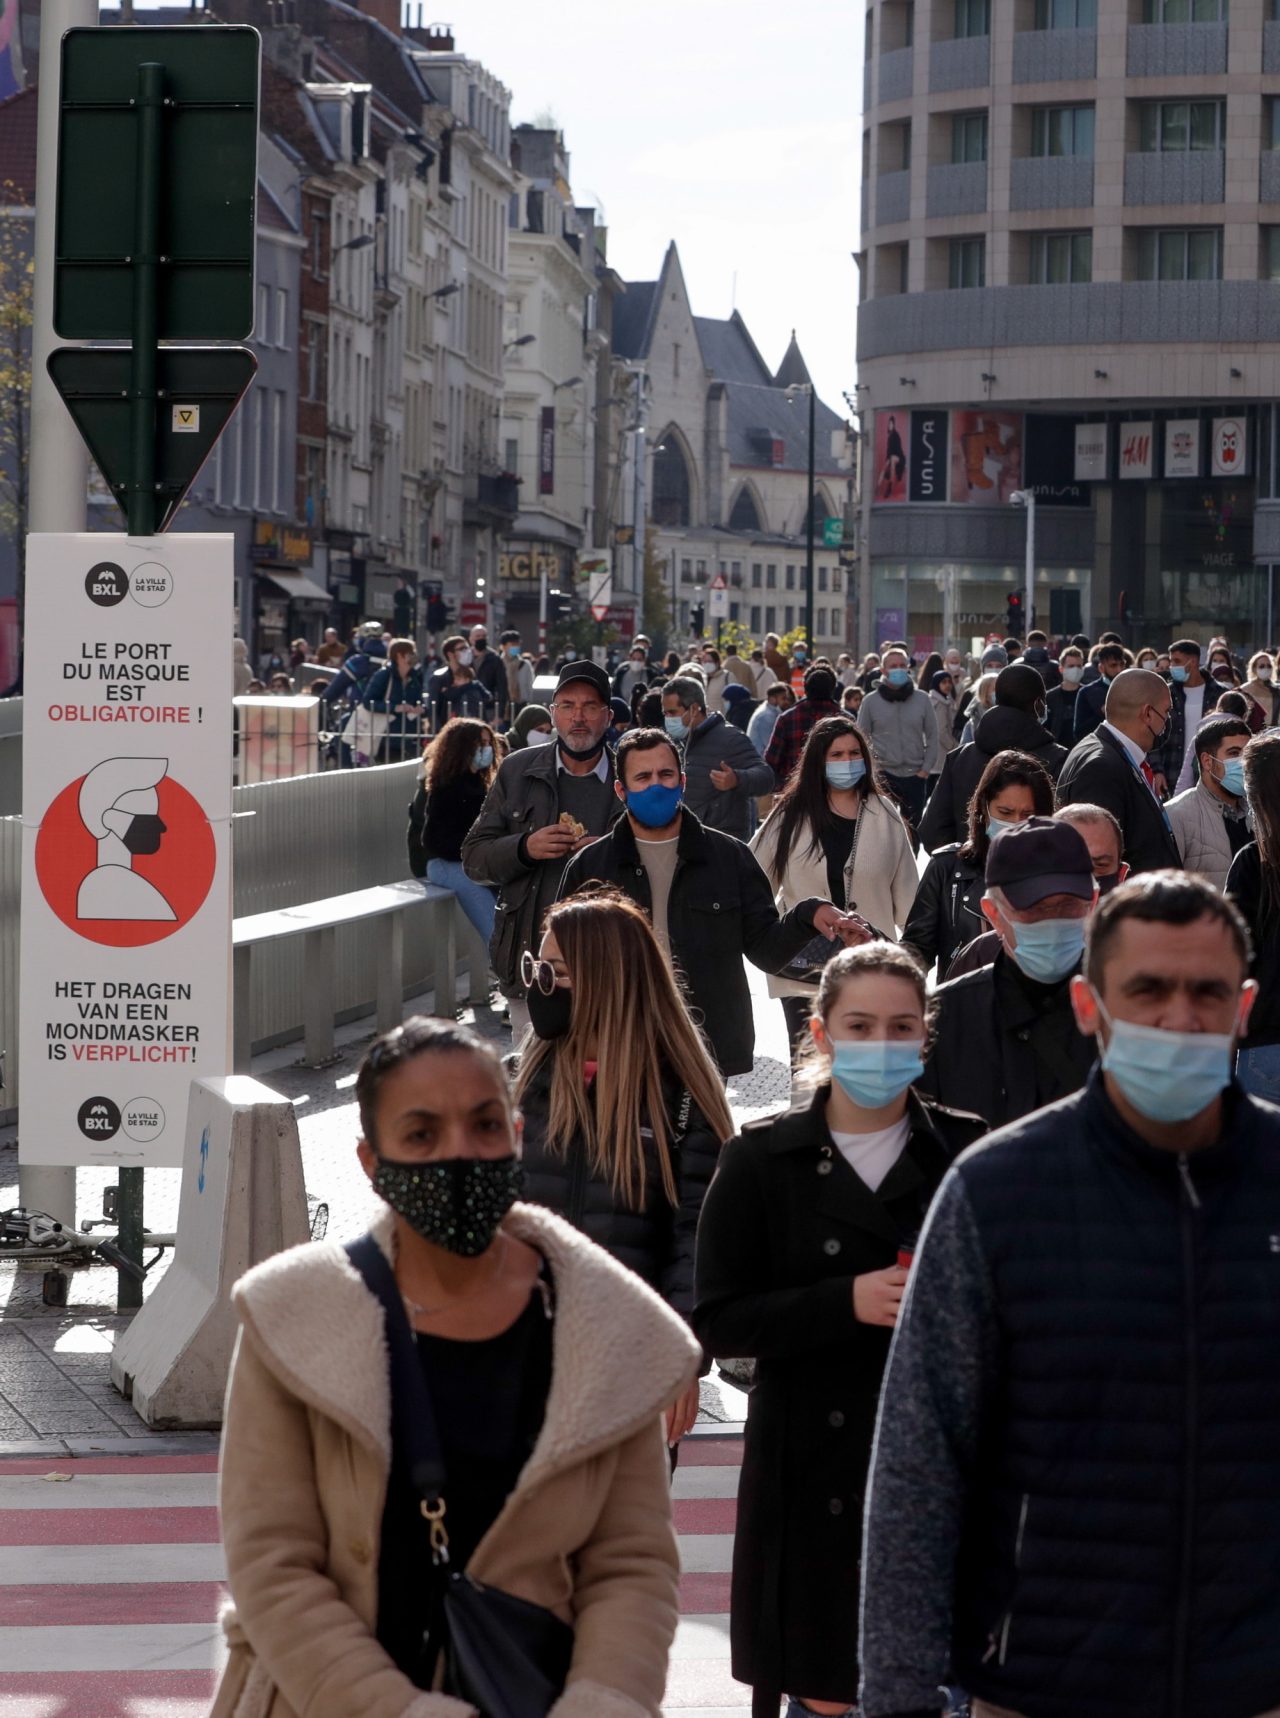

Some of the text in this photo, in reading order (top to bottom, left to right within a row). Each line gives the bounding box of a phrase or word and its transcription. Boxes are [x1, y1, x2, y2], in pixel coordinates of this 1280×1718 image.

[1202, 553, 1235, 566] VIAGE
[92, 583, 121, 596] BXL
[135, 577, 146, 586] LA
[82, 643, 172, 660] LE PORT
[64, 663, 189, 681] DU MASQUE
[107, 685, 146, 701] EST
[48, 705, 190, 723] OBLIGATOIRE
[56, 982, 190, 1000] HET DRAGEN
[78, 1003, 167, 1020] VAN EEN
[47, 1023, 199, 1041] MONDMASKER
[49, 1044, 195, 1062] IS VERPLICHT!
[85, 1117, 113, 1130] BXL
[128, 1112, 158, 1120] LA VILLE
[128, 1119, 158, 1127] DE STAD
